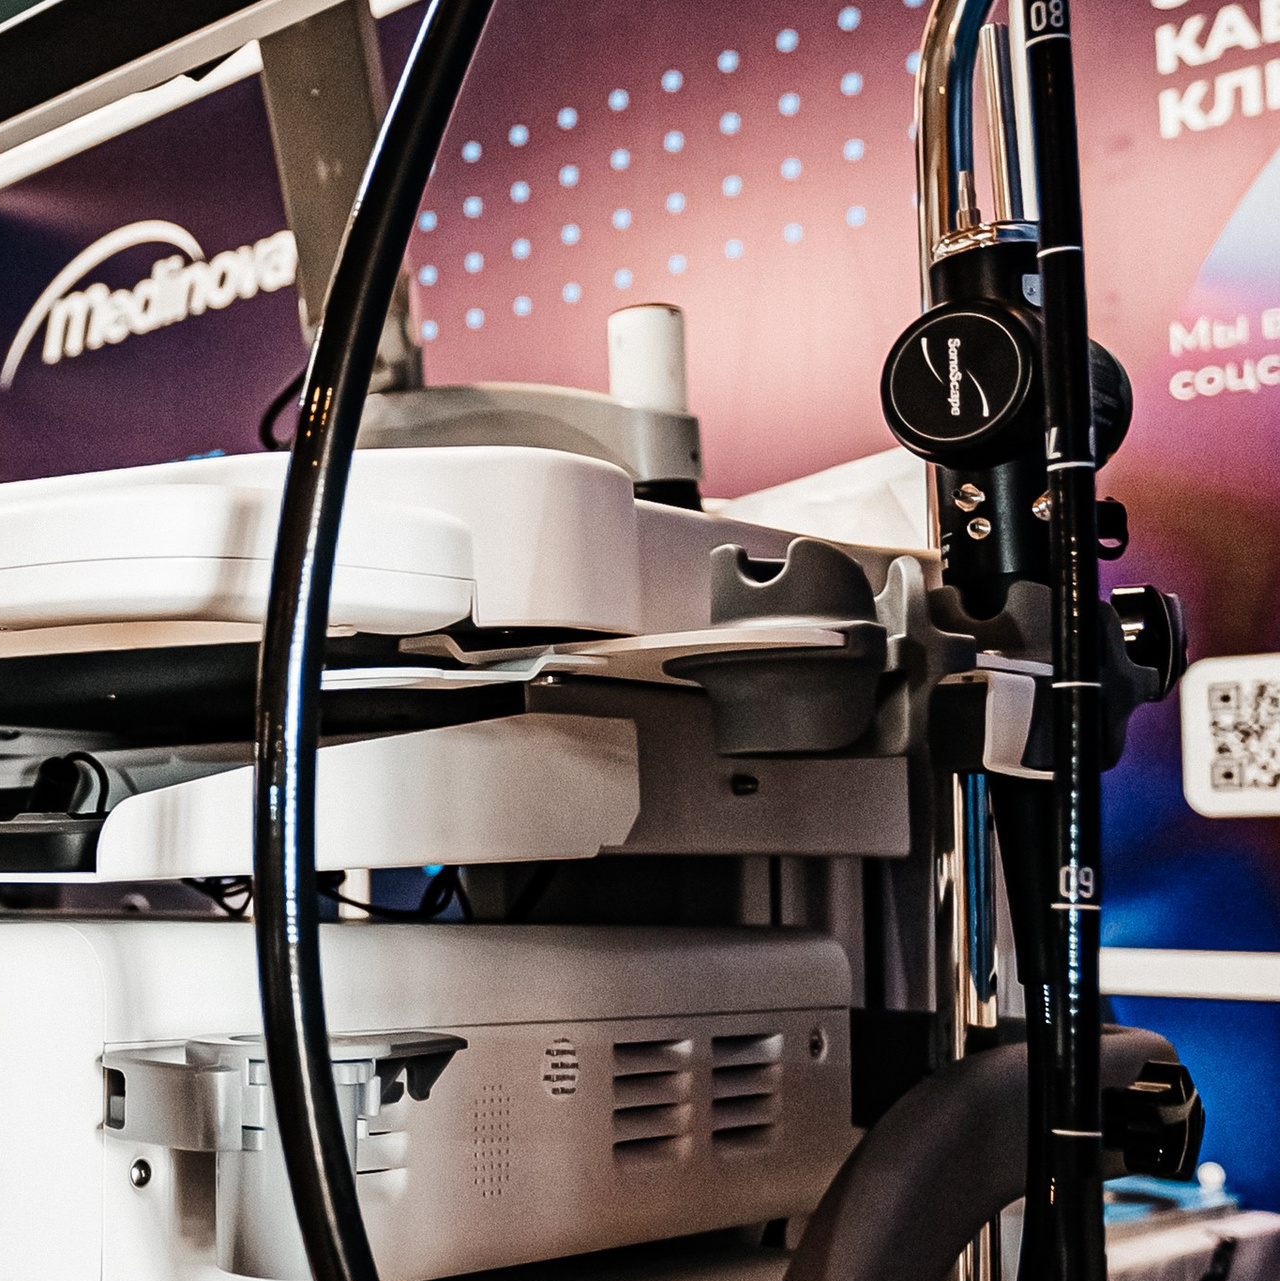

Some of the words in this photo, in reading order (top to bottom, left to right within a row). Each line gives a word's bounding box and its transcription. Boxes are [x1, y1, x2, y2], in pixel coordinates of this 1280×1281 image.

[42, 228, 298, 366] Medinova
[1168, 314, 1249, 358] Мы
[947, 338, 963, 416] SonoScape
